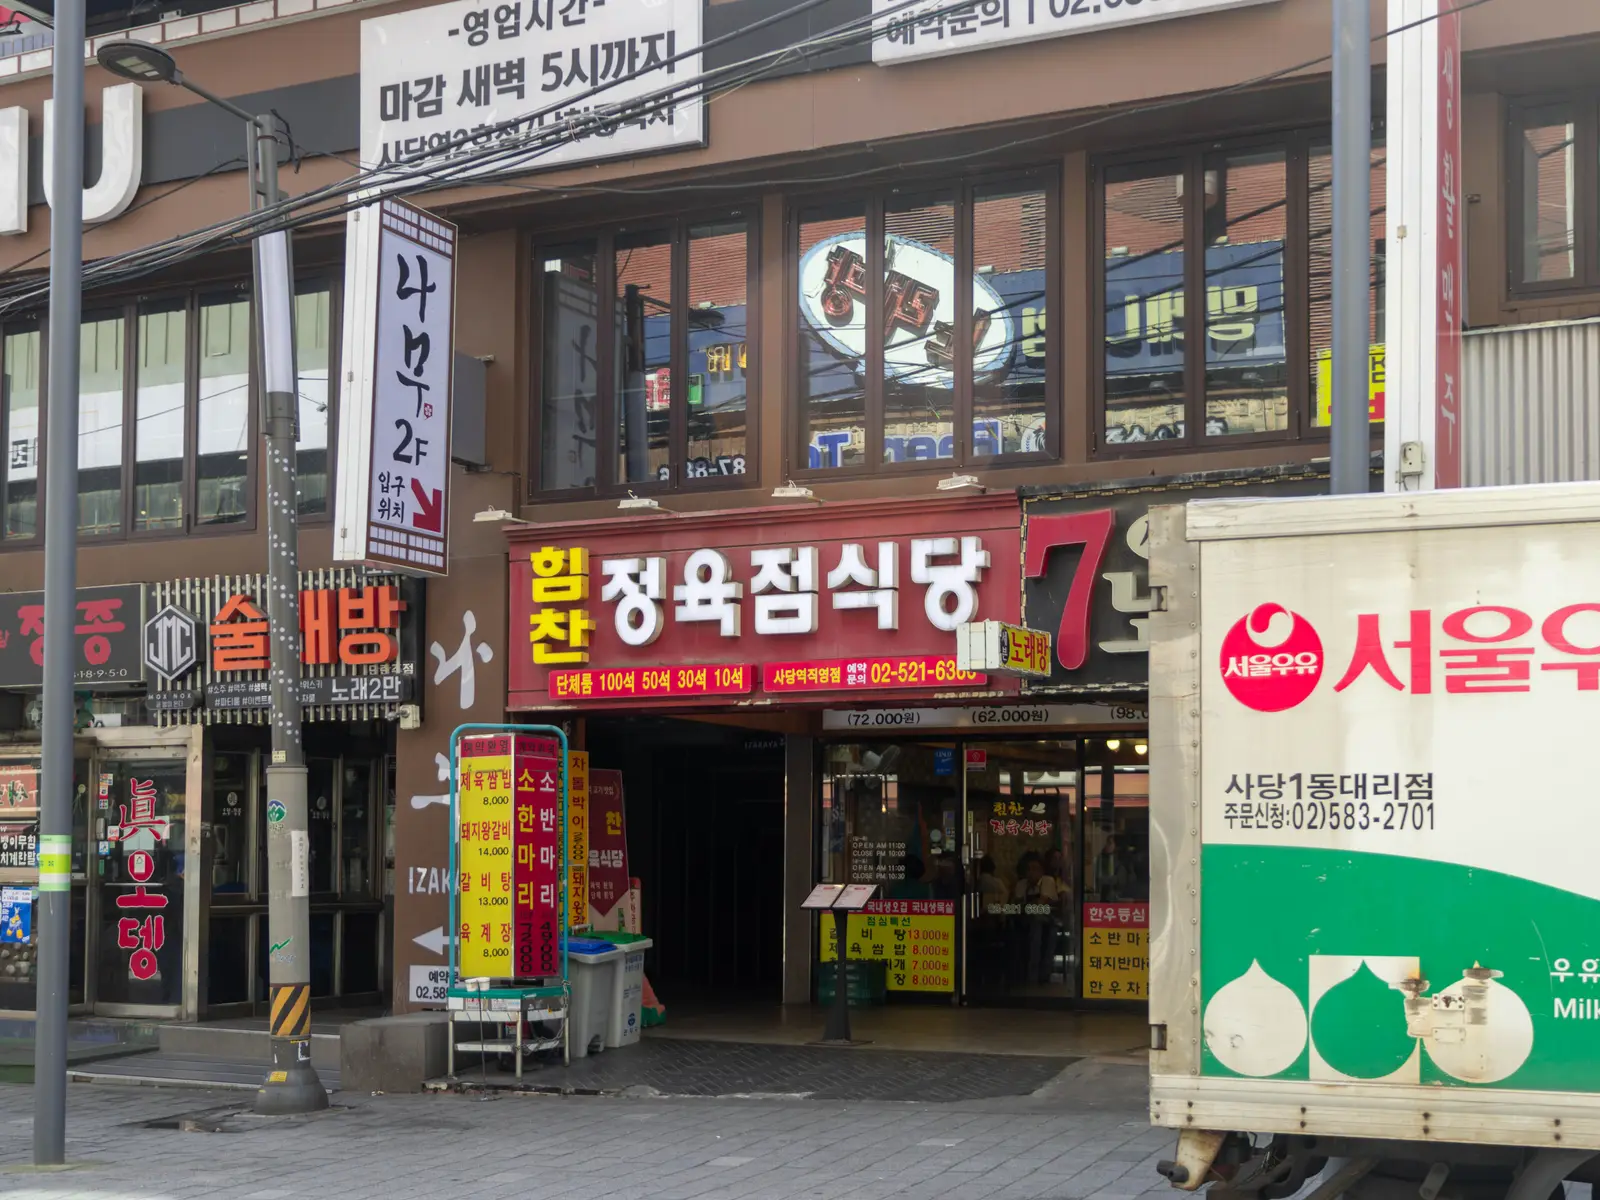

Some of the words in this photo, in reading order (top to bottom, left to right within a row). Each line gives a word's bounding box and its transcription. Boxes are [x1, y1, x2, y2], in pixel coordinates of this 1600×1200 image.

[379, 74, 447, 123] 마감
[456, 57, 526, 109] 새벽
[540, 30, 677, 92] 5시까지
[392, 418, 429, 466] 2F
[377, 470, 406, 498] 입구
[377, 497, 405, 524] 위치
[601, 536, 992, 647] 정육점식당
[148, 614, 192, 669] JMC
[1010, 630, 1050, 673] 노래방
[773, 666, 842, 687] 사당역직영점
[846, 663, 868, 674] 예약
[1223, 653, 1318, 679] 서울우유
[331, 675, 402, 702] 노래2만
[555, 673, 594, 697] 단체룸
[599, 670, 637, 695] 100석
[641, 669, 672, 693] 50석
[677, 668, 708, 691] 30석
[713, 667, 744, 690] 10석
[846, 673, 868, 685] 문의
[846, 712, 922, 727] (72.000원)
[971, 709, 1050, 725] (62.000원)
[460, 770, 512, 792] 제육쌈밥
[1224, 772, 1435, 801] 사당1동대리점
[482, 796, 509, 806] 8,000
[460, 820, 511, 841] 돼지왕갈비
[478, 847, 509, 856] 14,000
[460, 872, 512, 892] 갈비탕
[478, 897, 509, 907] 13,000
[1088, 907, 1146, 922] 한우등심
[460, 923, 512, 943] 육계장
[482, 948, 509, 958] 8,000
